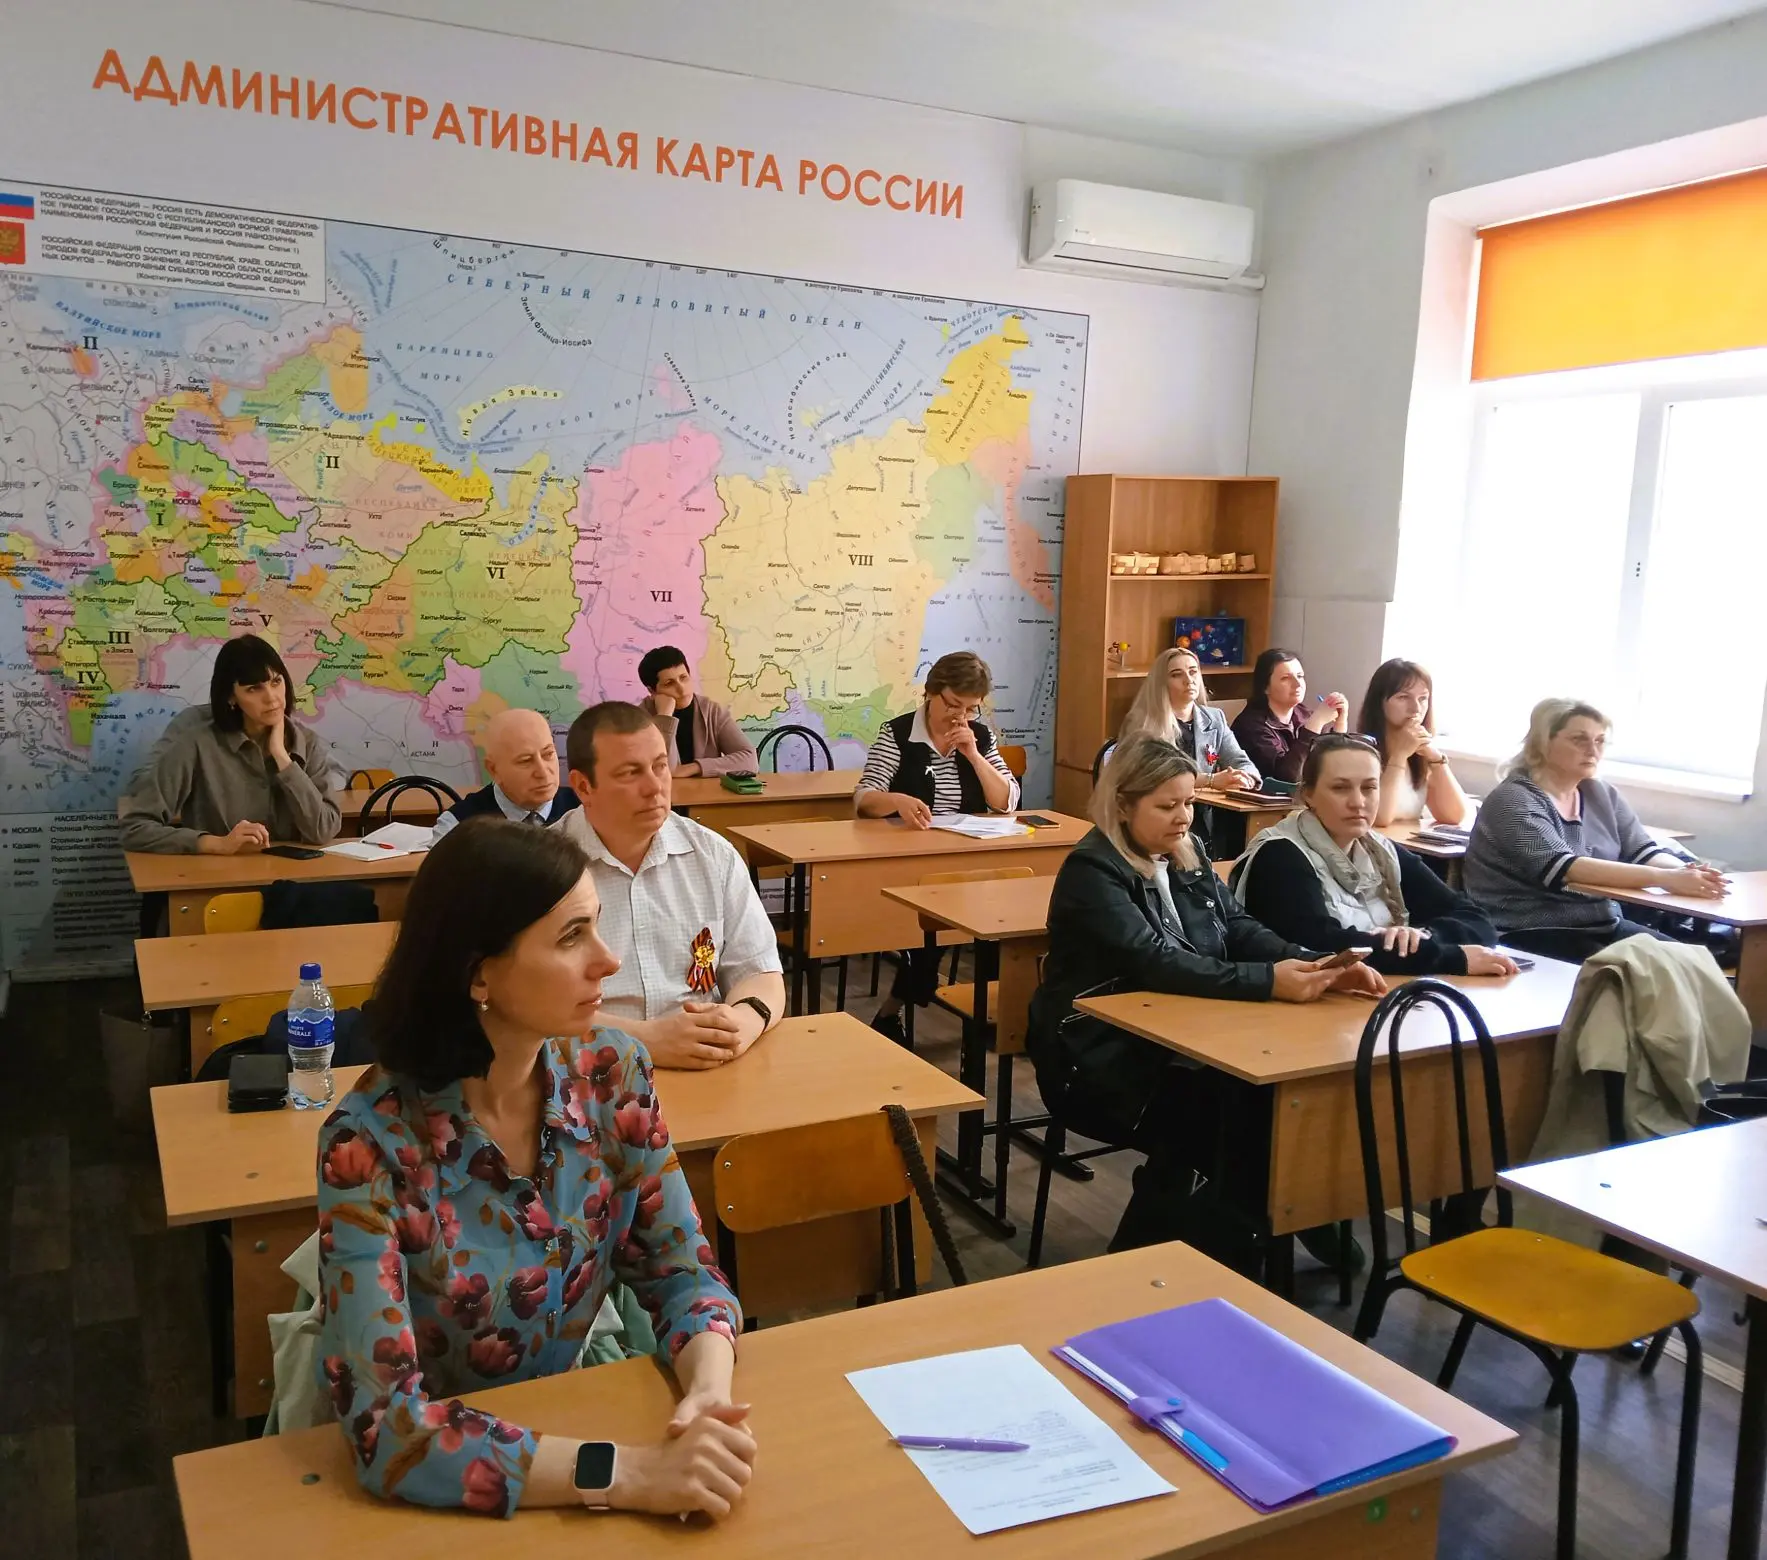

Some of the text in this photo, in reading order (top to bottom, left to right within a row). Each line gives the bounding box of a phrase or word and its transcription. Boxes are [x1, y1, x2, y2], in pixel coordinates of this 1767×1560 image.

[92, 48, 964, 219] АДМИНИСТРАТИВНАЯ КАРТА РОССИИ
[40, 190, 92, 203] РОССИЙСКАЯ
[95, 197, 141, 208] ФЕДЕРАЦИЯ
[152, 203, 183, 214] РОССИЯ
[184, 207, 203, 217] ЕСТЬ
[205, 210, 275, 224] ДЕМОКРАТИЧЕСКОЕ
[40, 200, 56, 209] НОЕ
[59, 202, 99, 213] ПРАВОВОЕ
[101, 206, 155, 219] ГОСУДАРСТВО
[164, 213, 236, 229] РЕСПУБЛИКАНСКОЙ
[238, 222, 271, 233] ФОРМОЙ
[40, 208, 104, 222] НАИМЕНОВАНИЯ
[106, 215, 157, 228] РОССИЙСКАЯ
[158, 220, 203, 234] ФЕДЕРАЦИЯ
[213, 228, 243, 238] РОССИЯ
[41, 234, 93, 247] РОССИЙСКАЯ
[95, 240, 141, 252] ФЕДЕРАЦИЯ
[143, 246, 178, 256] СОСТОИТ
[180, 250, 191, 258] ИЗ
[432, 238, 516, 265] Шпицберген
[41, 243, 78, 254] ГОРОДОВ
[80, 247, 141, 260] ФЕДЕРАЛЬНОГО
[184, 259, 236, 271] АВТОНОМНОЙ
[41, 252, 58, 261] НЫХ
[60, 253, 95, 264] ОКРУГОВ
[106, 258, 166, 272] РАВНОПРАВНЫХ
[211, 269, 261, 282] РОССИЙСКОЙ
[447, 273, 863, 331] СЕВЕРНЫЙ ЛЕДОВИТЫЙ ОКЕАН
[55, 301, 128, 336] БАЛТИЙСКОЕ
[131, 329, 163, 339] МОРЕ
[520, 296, 592, 347] Земля Франца-Иосифа
[950, 304, 999, 328] ЧУКОТСКОЕ
[974, 323, 994, 337] МОРЕ
[26, 343, 77, 353] Калининград
[396, 342, 495, 359] БАРЕНЦЕВО
[420, 372, 463, 383] МОРЕ
[508, 388, 559, 399] Земля
[883, 381, 903, 408] МОРЕ
[154, 405, 175, 414] Псков
[703, 396, 737, 423] МОРЕ
[347, 411, 375, 422] МОРЕ
[327, 432, 366, 441] Архангельск
[112, 481, 138, 489] Брянск
[143, 485, 167, 495] Калуга
[208, 484, 243, 493] Ярославль
[172, 498, 203, 507] МОСКВА
[103, 509, 125, 518] Курск
[105, 529, 138, 539] Белгород
[258, 549, 298, 559] Йошкар-Ола
[304, 543, 324, 552] Киров
[847, 554, 874, 567] VIII
[486, 566, 506, 581] VI
[650, 590, 673, 603] VII
[38, 607, 76, 617] Краснодар
[259, 614, 274, 628] V
[21, 625, 48, 634] Майкоп
[142, 625, 177, 634] Волгоград
[108, 630, 131, 645] III
[110, 647, 134, 655] Элиста
[76, 670, 101, 685] IV
[363, 670, 385, 681] Курган
[11, 826, 43, 835] МОСКВА
